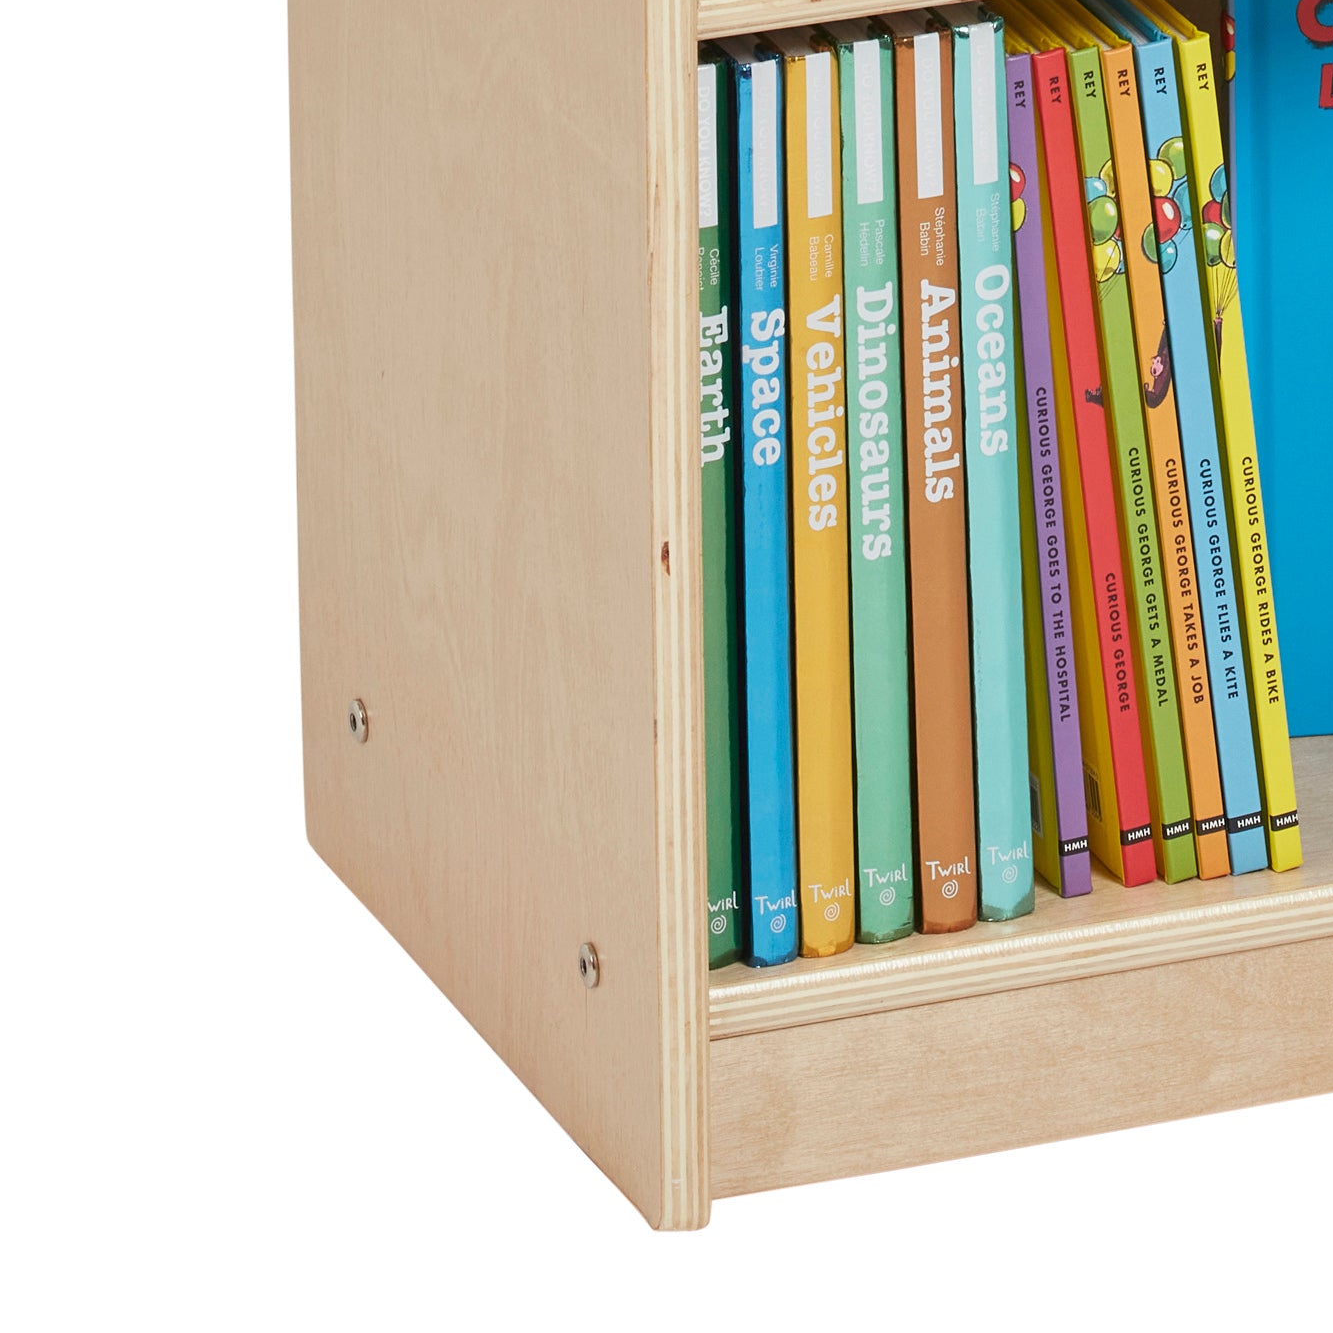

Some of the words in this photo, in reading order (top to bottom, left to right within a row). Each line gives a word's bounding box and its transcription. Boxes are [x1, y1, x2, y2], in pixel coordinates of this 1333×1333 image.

[1014, 81, 1026, 109] REY
[920, 222, 929, 257] Babin
[935, 206, 945, 266] Stéphanie
[699, 306, 730, 467] Earth
[743, 308, 785, 466] Space
[921, 279, 960, 504] Animals
[975, 264, 1010, 456] Oceans
[806, 294, 844, 532] Vehicles
[857, 281, 896, 561] Dinosaurs
[1036, 386, 1050, 457] CURIOUS
[1042, 463, 1056, 528] GEORGE
[1242, 457, 1258, 526] CURIOUS
[1048, 535, 1059, 573] GOES
[1251, 533, 1266, 597] GEORGE
[1052, 583, 1061, 603] TO
[1054, 610, 1065, 640] THE
[1259, 603, 1272, 646] RIDES
[1056, 647, 1071, 722] HOSPITAL
[1265, 654, 1274, 664] A
[1267, 670, 1279, 704] BIKE
[1064, 839, 1088, 852] HMH
